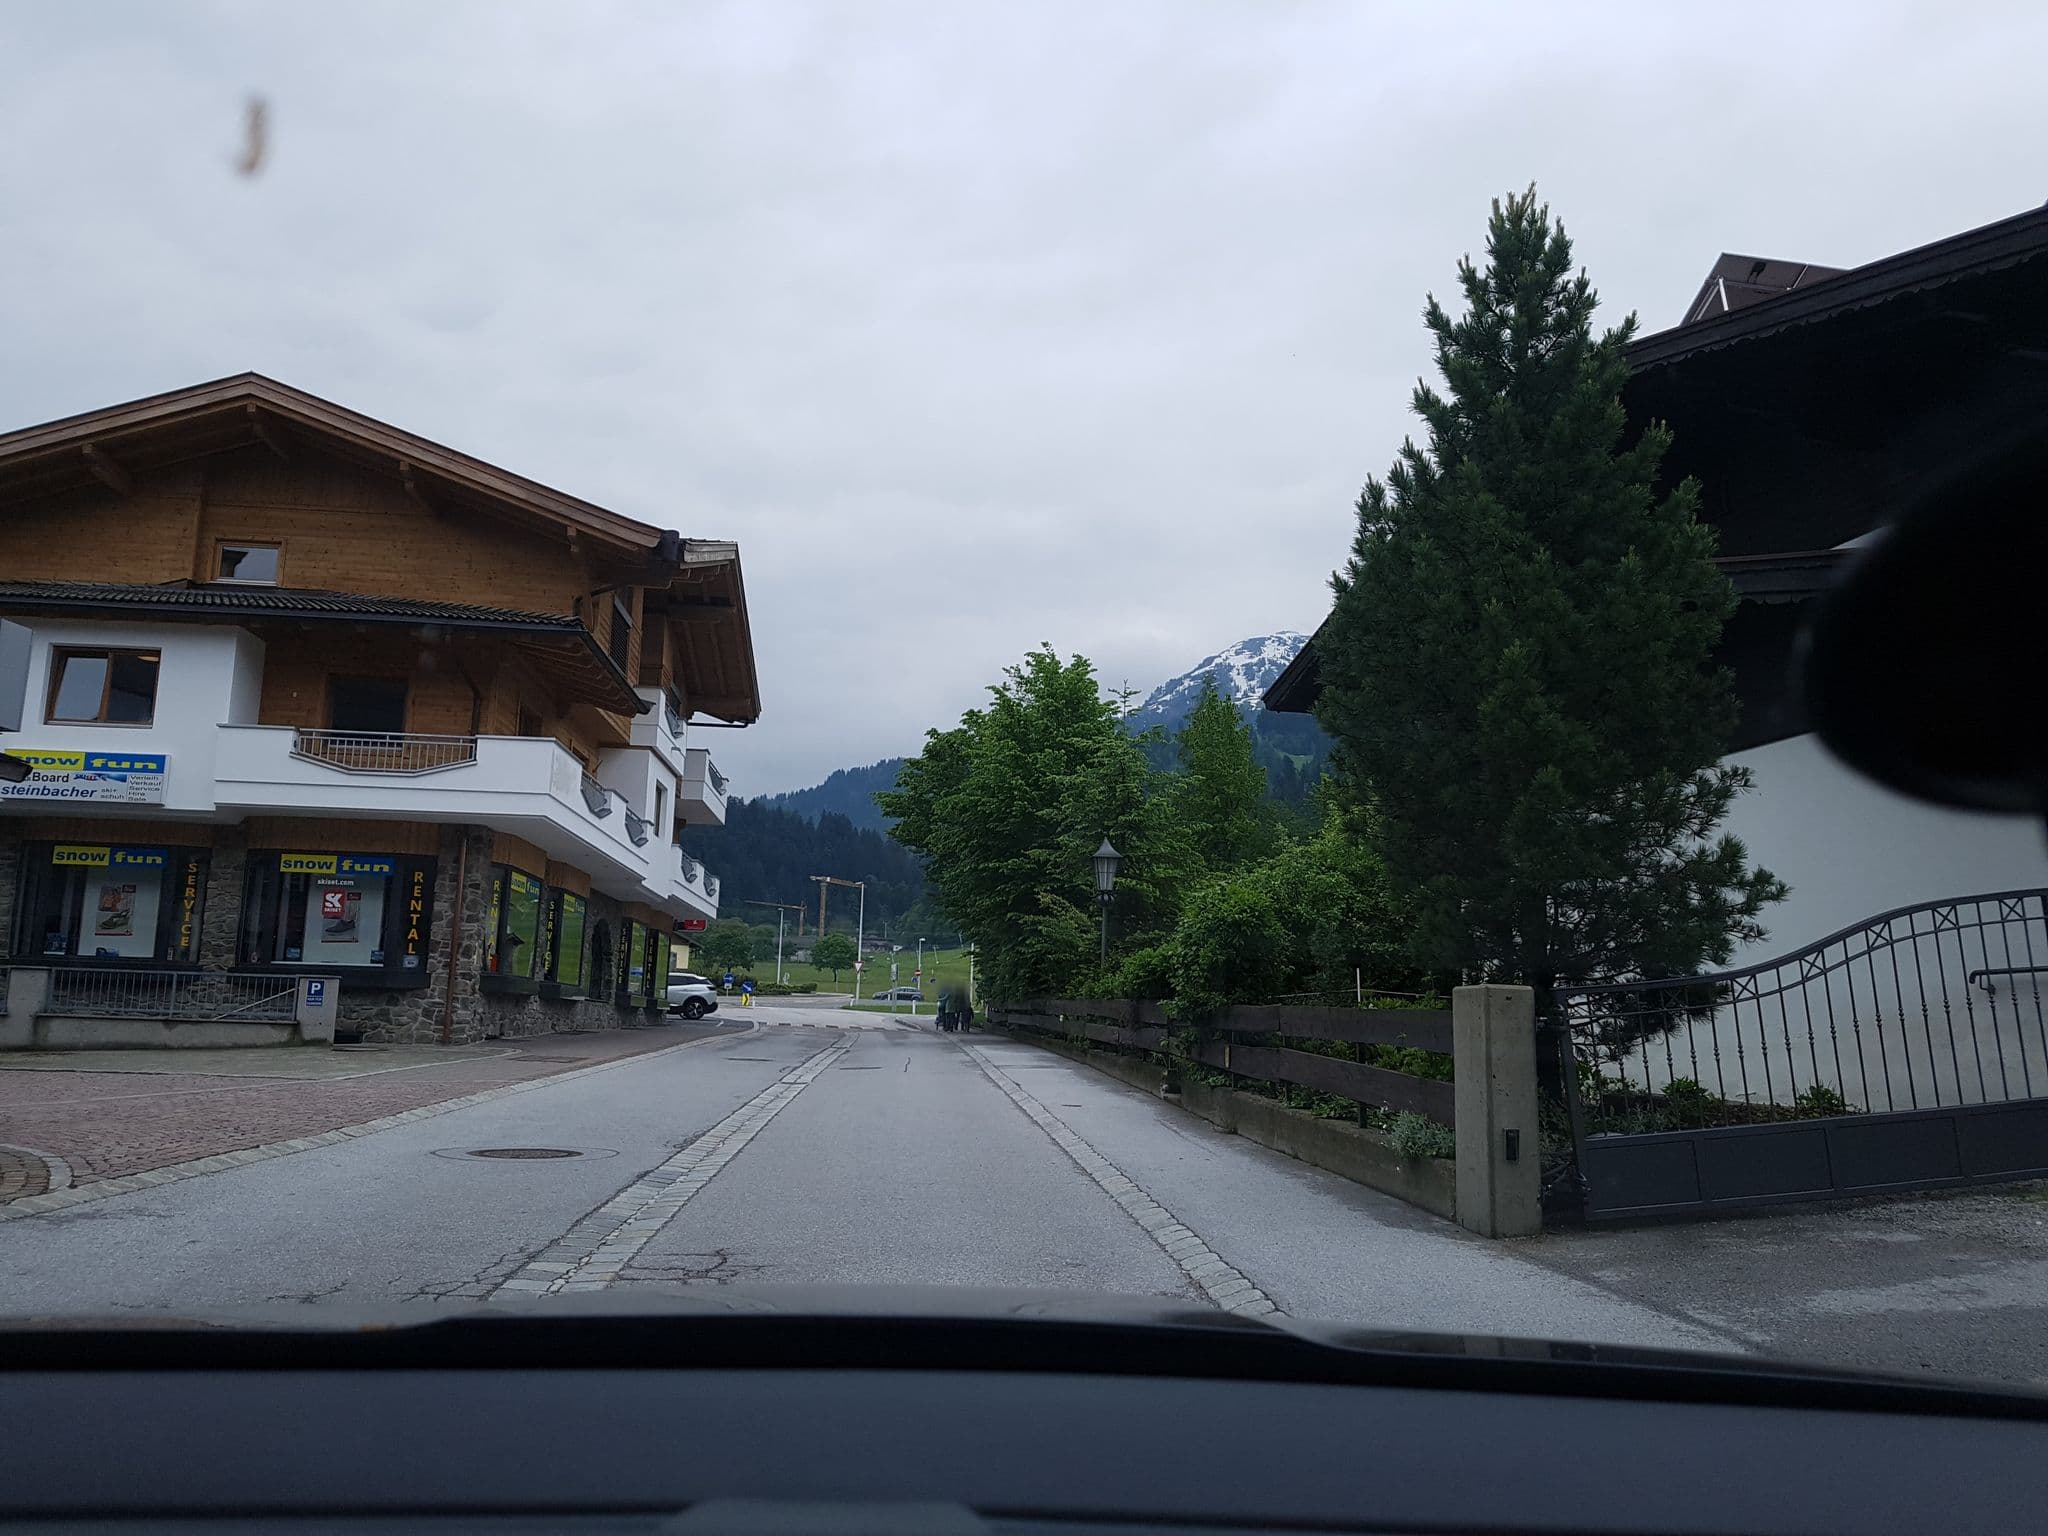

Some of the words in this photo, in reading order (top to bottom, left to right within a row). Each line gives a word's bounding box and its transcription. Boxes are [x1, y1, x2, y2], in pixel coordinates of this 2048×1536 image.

[18, 756, 80, 766] now
[90, 758, 157, 769] fun
[32, 772, 69, 783] Board
[1, 784, 98, 798] steinbacher
[55, 851, 107, 862] snow
[114, 852, 162, 864] fun
[282, 859, 334, 870] snow
[341, 860, 389, 872] fun
[317, 878, 354, 886] skiset.com
[527, 881, 540, 895] fun
[180, 863, 198, 947] SERVICE
[407, 871, 424, 954] RENTAL
[488, 880, 500, 960] RENTAL
[545, 901, 555, 970] SERVICE
[311, 982, 321, 994] P
